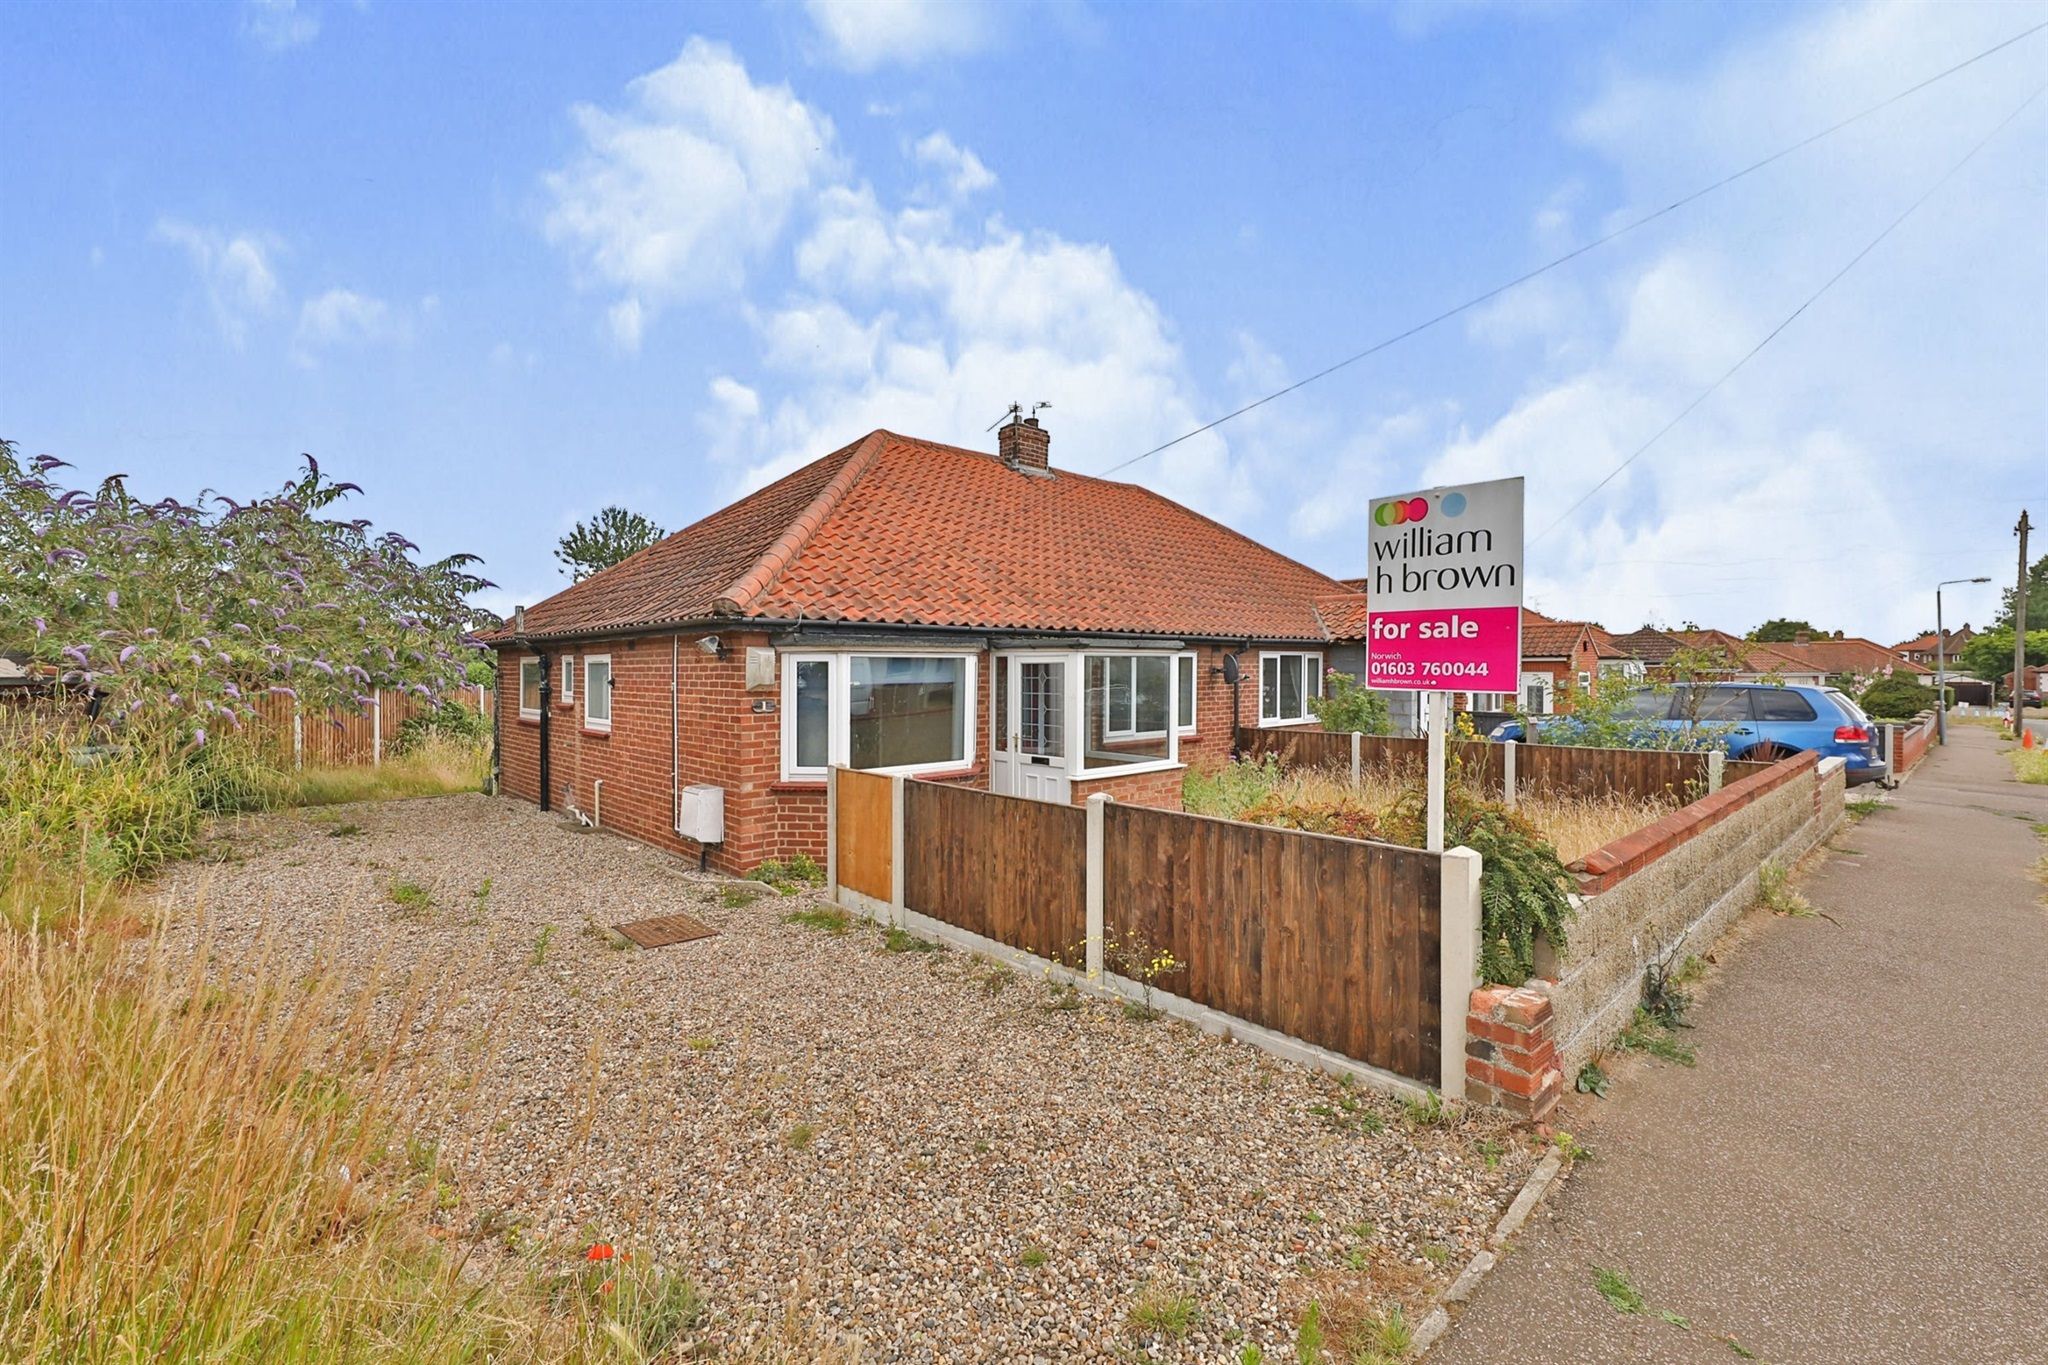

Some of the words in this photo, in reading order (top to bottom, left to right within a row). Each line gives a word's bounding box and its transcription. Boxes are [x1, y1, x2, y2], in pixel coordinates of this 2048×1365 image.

[1374, 527, 1492, 561] william
[1376, 566, 1393, 594] h
[1402, 563, 1515, 593] brown
[1372, 618, 1411, 639] for
[1418, 615, 1479, 639] sale
[1371, 652, 1402, 660] Norwich
[1371, 662, 1415, 675] 01603
[1421, 662, 1489, 676] 760044
